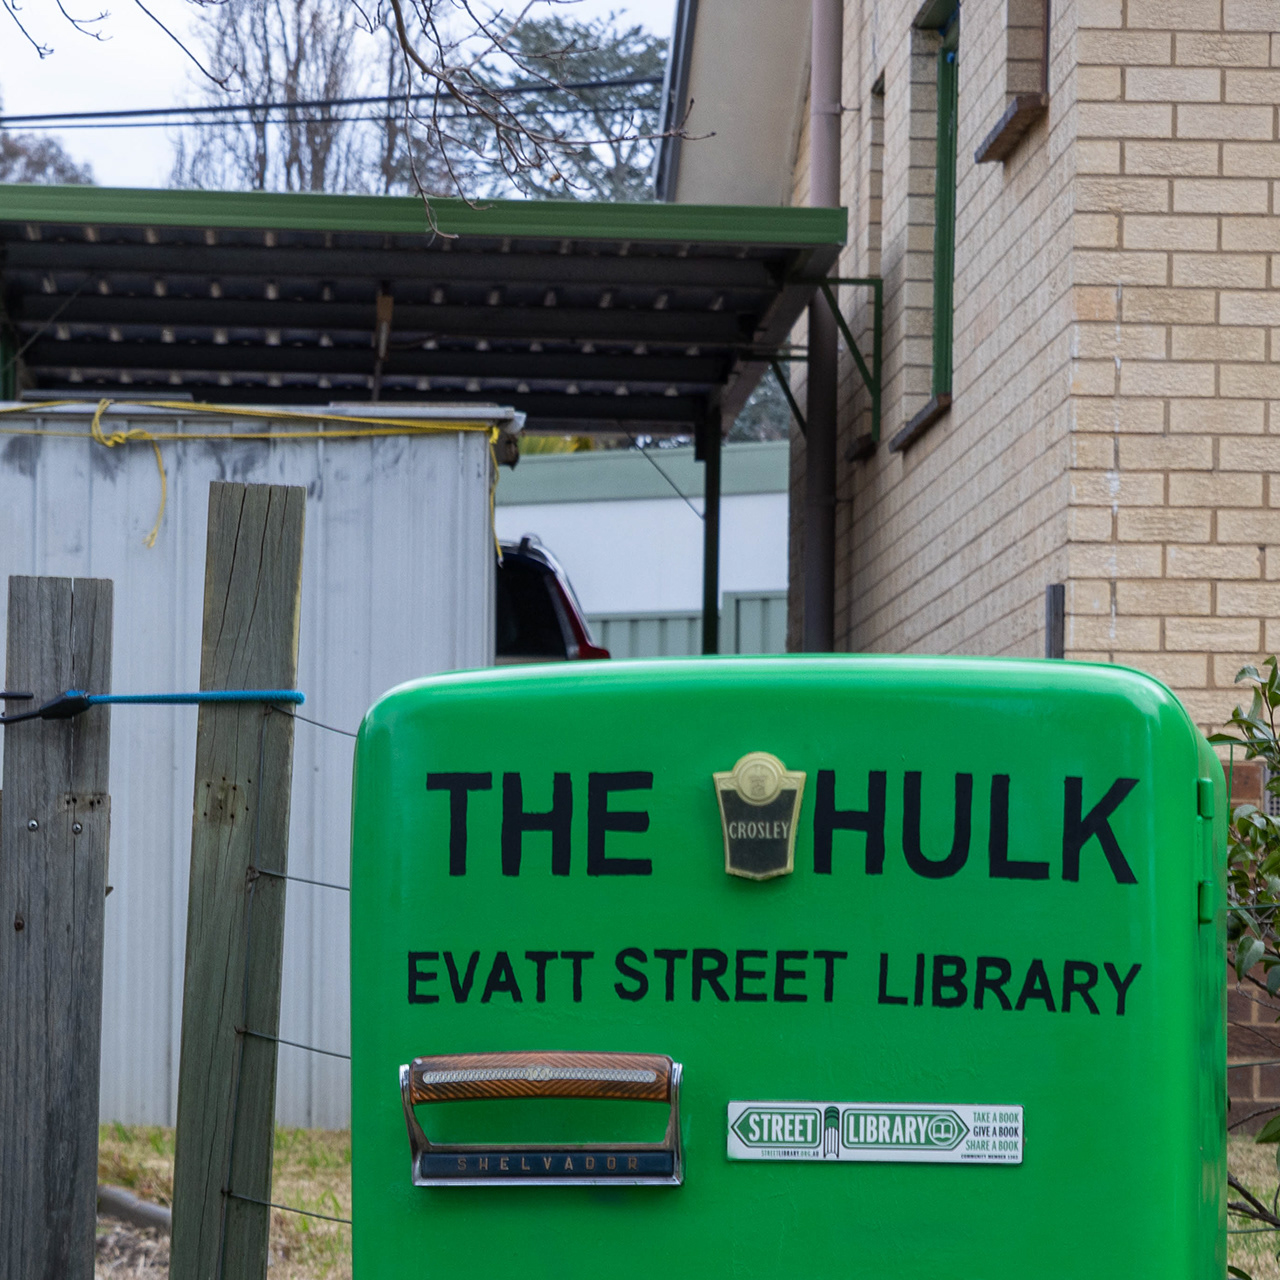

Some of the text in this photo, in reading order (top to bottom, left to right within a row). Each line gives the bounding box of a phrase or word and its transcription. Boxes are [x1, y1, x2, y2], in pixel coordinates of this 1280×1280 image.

[426, 769, 1140, 885] THE HULK
[728, 821, 790, 839] CROSLEY
[407, 947, 1142, 1016] EVATT STREET LIBRARY
[973, 1111, 1019, 1124] TAKE A BOOK
[748, 1113, 929, 1144] STREET LIBRARY
[973, 1125, 1019, 1138] GIVE A BOOK
[965, 1140, 1019, 1151] SHARE A BOOK
[457, 1156, 640, 1171] SHELVADOR
